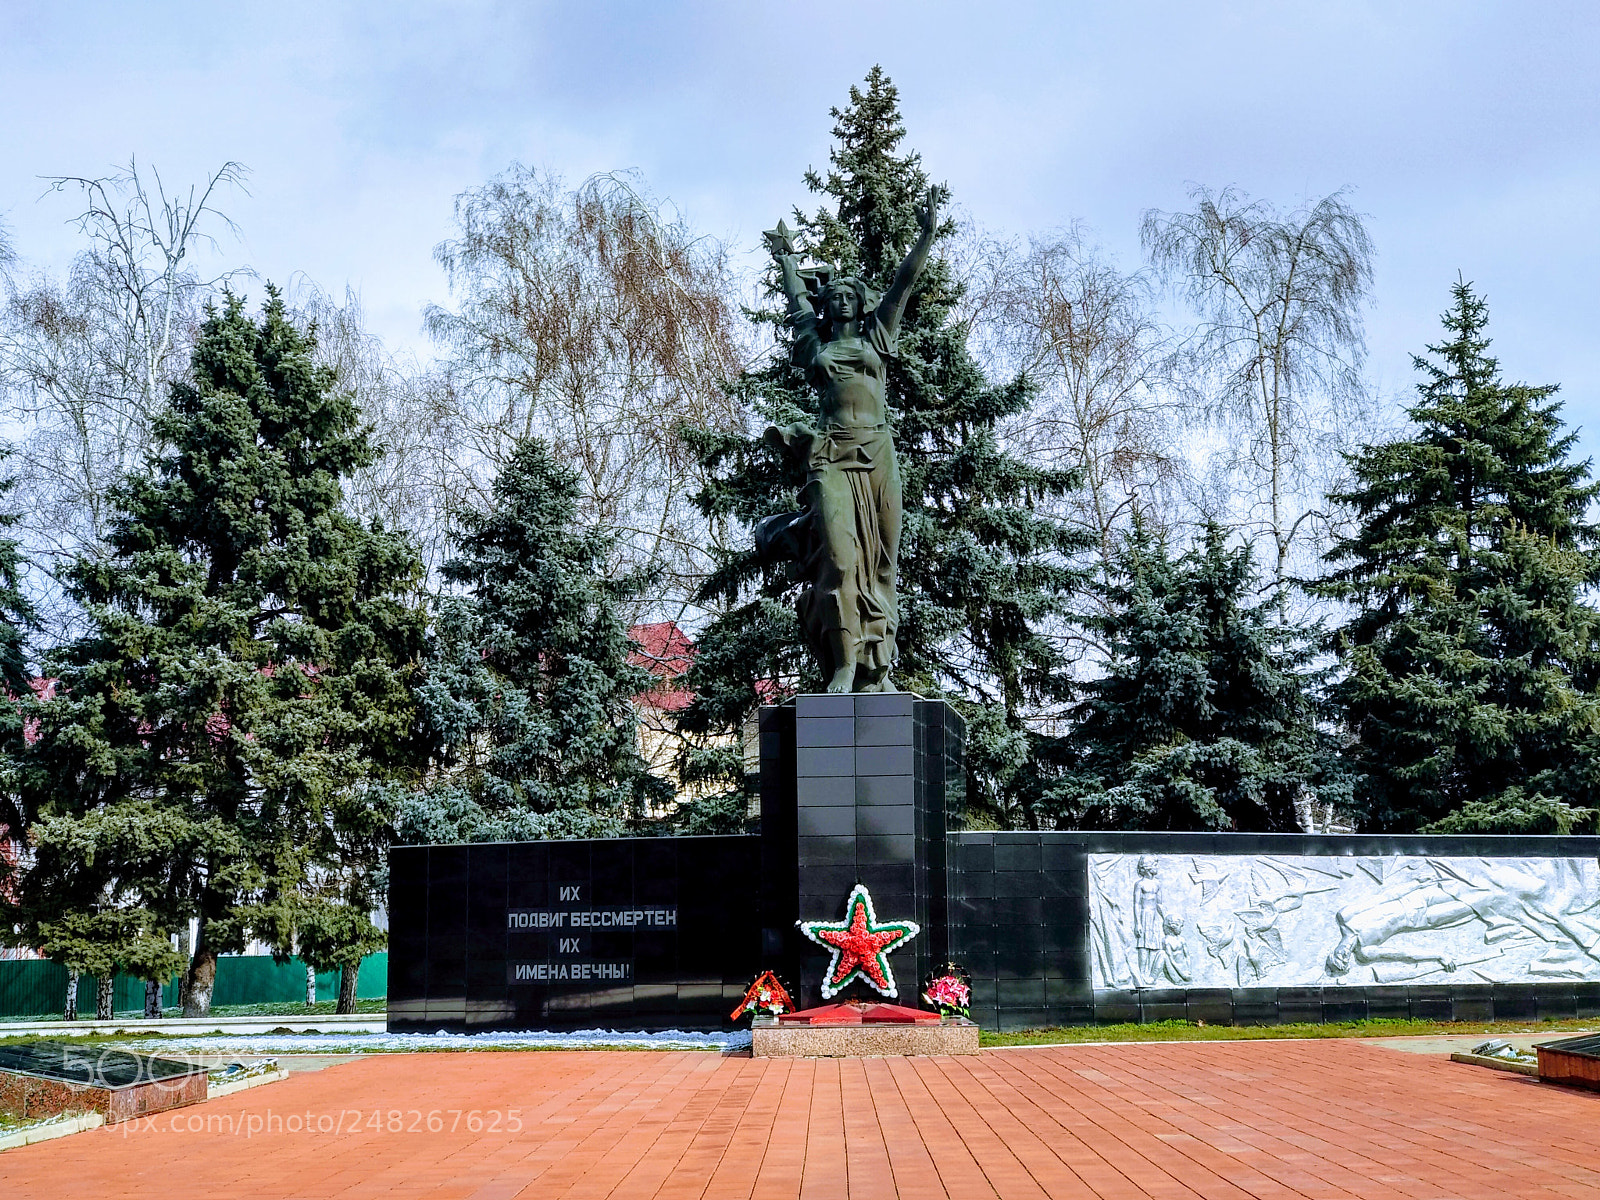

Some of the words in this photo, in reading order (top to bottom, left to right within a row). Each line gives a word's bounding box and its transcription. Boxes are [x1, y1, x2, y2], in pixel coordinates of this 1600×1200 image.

[559, 886, 580, 901] ИХ
[508, 912, 568, 928] ПОДВИГ
[570, 911, 677, 927] БЕССМЕРТЕН
[559, 938, 580, 953] ИХ
[515, 965, 568, 980] ИМЕНА
[571, 964, 630, 980] ВЕЧНЫ!
